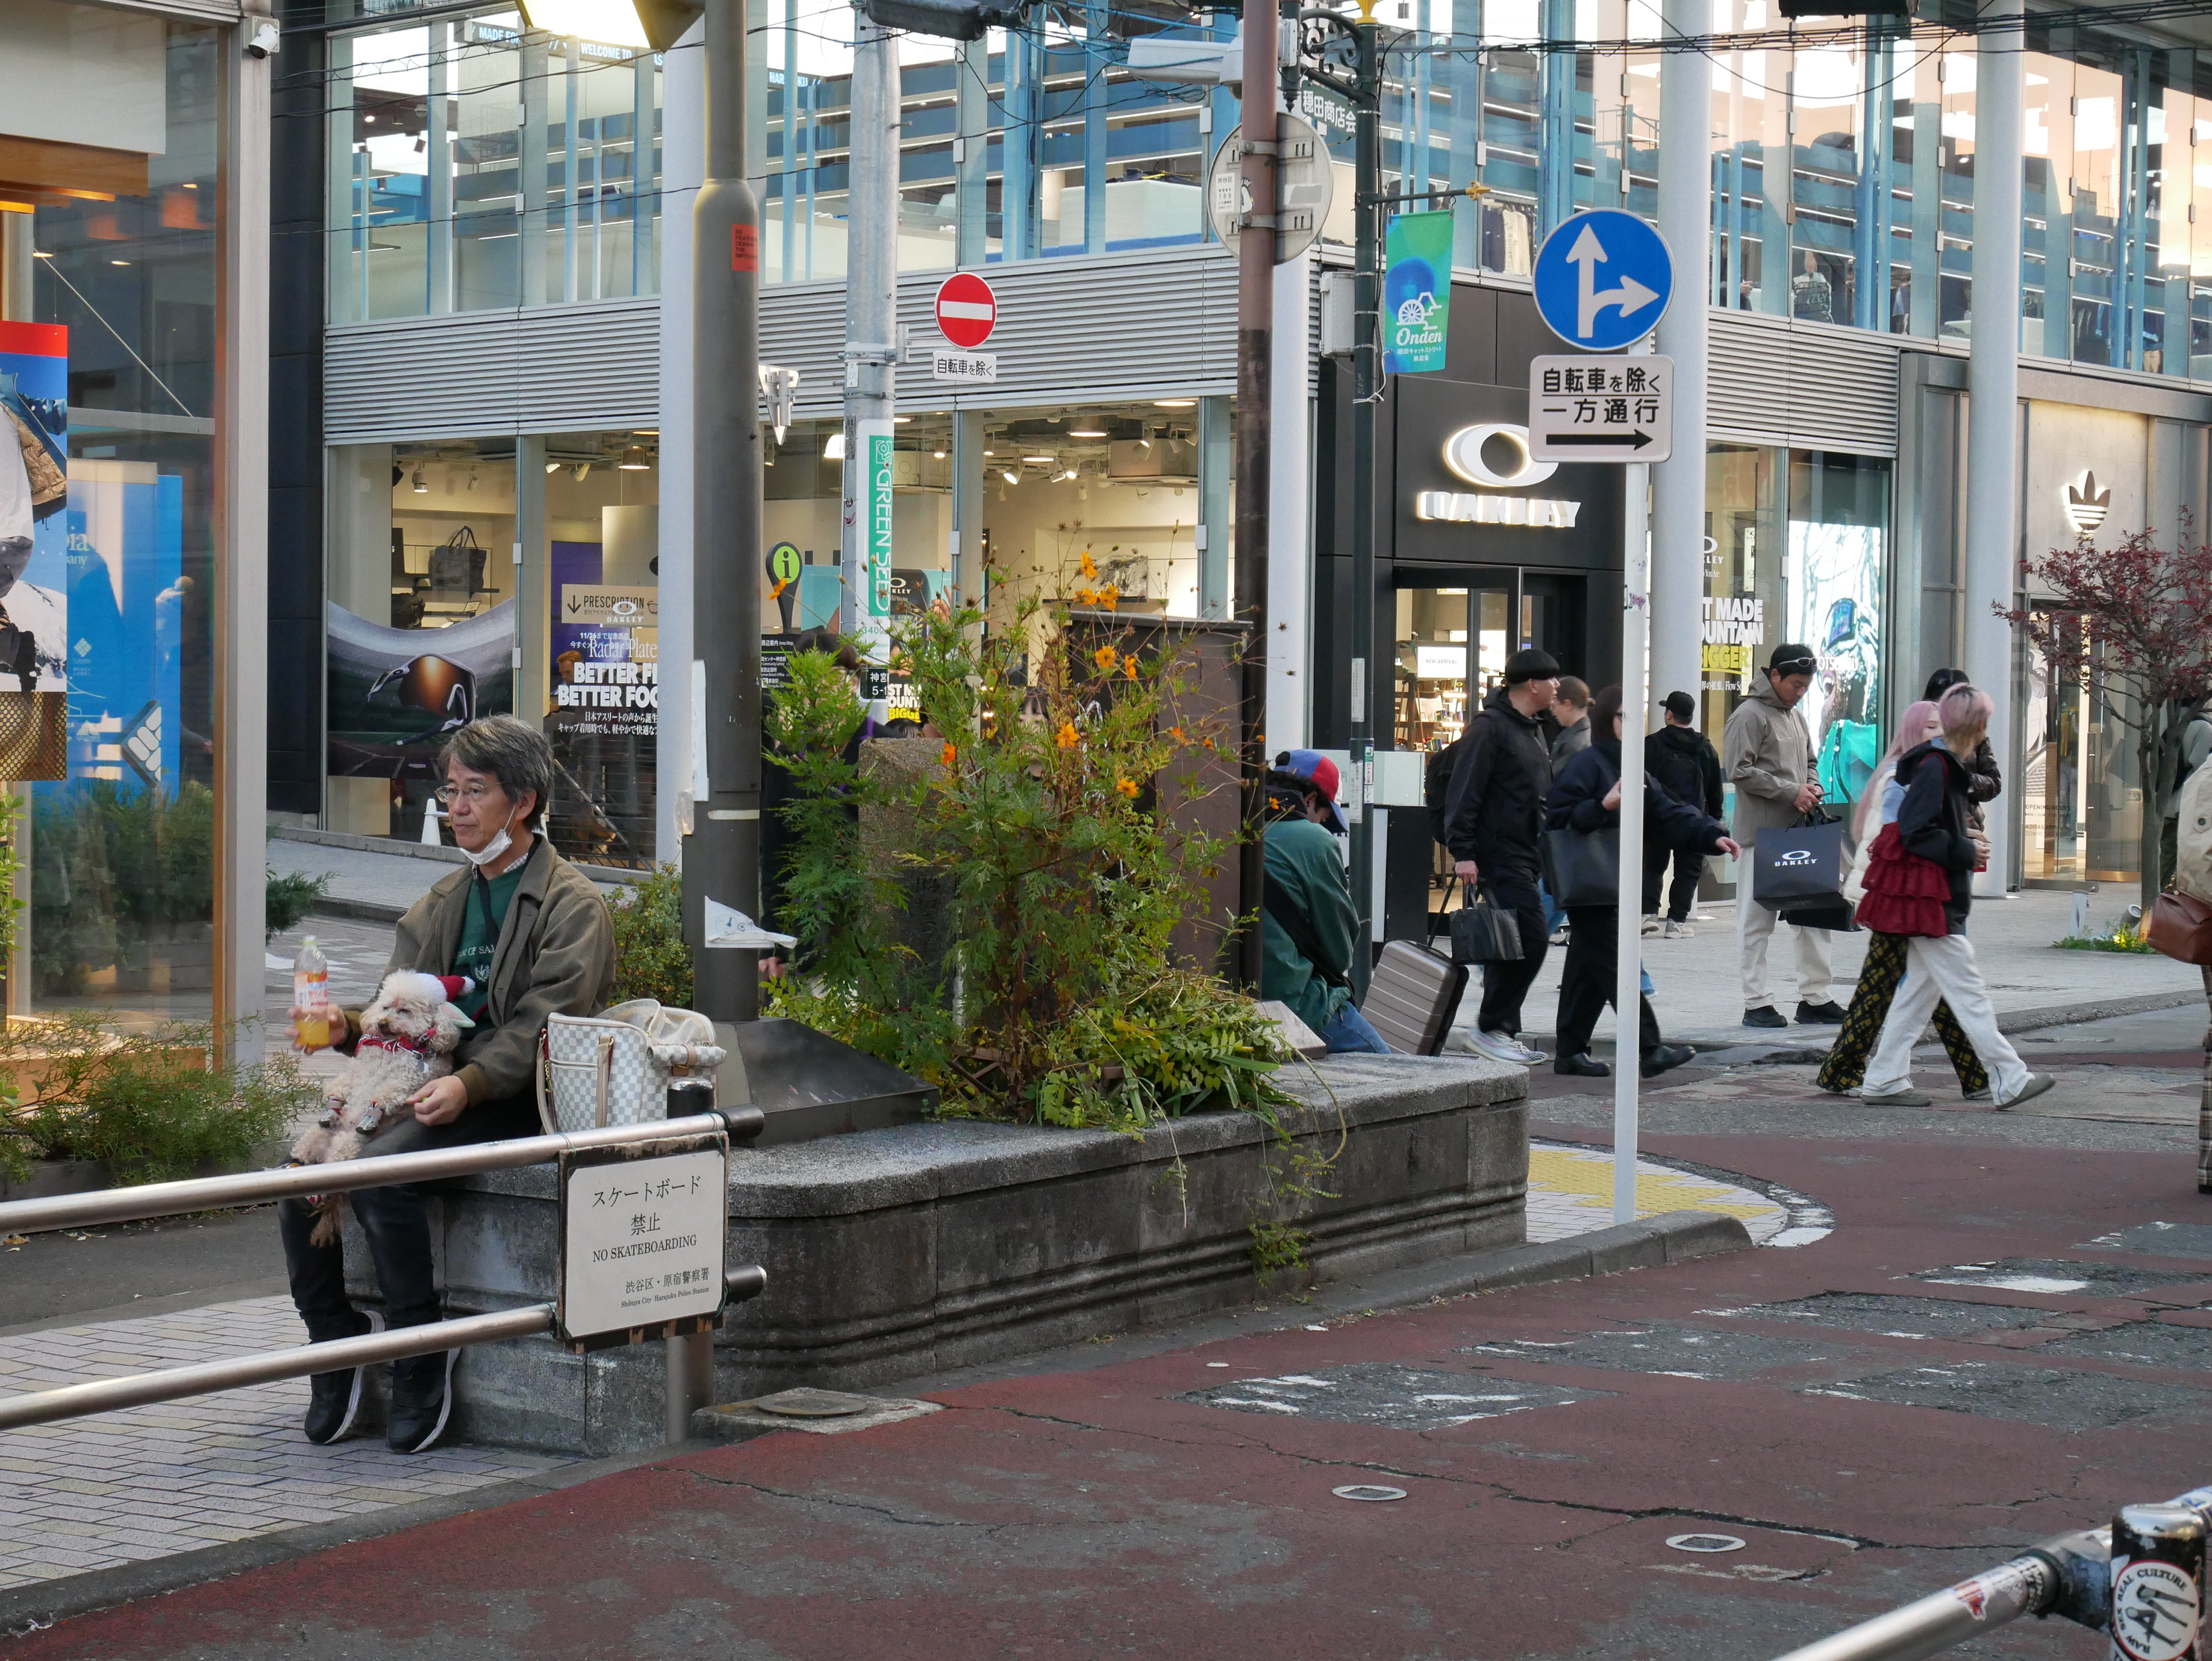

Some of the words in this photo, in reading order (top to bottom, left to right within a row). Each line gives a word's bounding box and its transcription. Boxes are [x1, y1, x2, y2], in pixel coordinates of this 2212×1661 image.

[479, 27, 503, 41] MADE
[581, 42, 620, 59] WELCOME
[622, 49, 632, 60] TO
[1303, 90, 1356, 133] 穏田商店会
[1396, 327, 1443, 346] Onden
[937, 358, 993, 376] 自転車を除く
[1543, 366, 1660, 393] 自転車を除く
[1543, 398, 1660, 424] 一方通行
[876, 468, 892, 547] GREEN
[1418, 491, 1582, 528] OAKLEY
[1715, 597, 1763, 622] MADE
[628, 637, 658, 658] Plate
[574, 662, 639, 684] BETTER
[642, 663, 658, 684] FI
[558, 684, 623, 707] BETTER
[1774, 858, 1818, 867] OAKLEY
[592, 1175, 701, 1208] スケートボード
[630, 1212, 661, 1236] 禁止
[592, 1249, 608, 1263] NO
[611, 1235, 697, 1260] SKATEBOARDING
[626, 1267, 710, 1294] 渋谷区・原宿警察署
[621, 1299, 641, 1308] Shibuya
[642, 1296, 652, 1305] City
[654, 1292, 677, 1303] Harajuku
[677, 1289, 692, 1298] Police
[692, 1286, 710, 1295] Station
[2117, 1575, 2135, 1602] REAL
[2137, 1568, 2188, 1592] CULTURE
